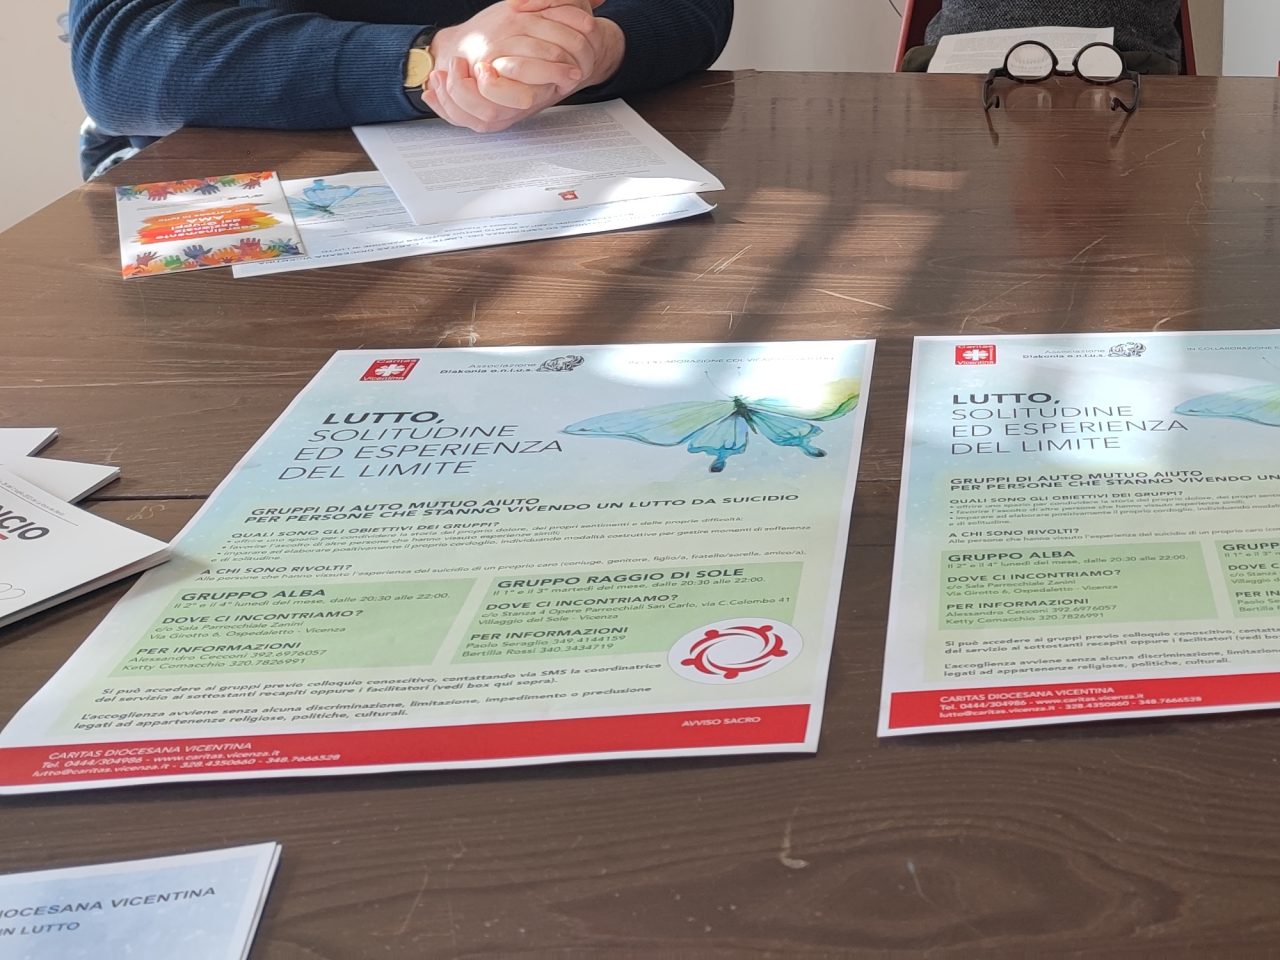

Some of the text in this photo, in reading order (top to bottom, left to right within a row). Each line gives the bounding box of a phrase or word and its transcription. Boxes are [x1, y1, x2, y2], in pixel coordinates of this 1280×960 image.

[186, 215, 224, 223] AMA
[952, 392, 1060, 405] LUTTO,
[322, 410, 444, 424] LUTTO,
[951, 405, 1132, 420] SOLITUDINE
[308, 424, 518, 442] SOLITUDINE
[951, 419, 1188, 438] ED ESPERIENZA
[293, 439, 562, 461] ED ESPERIENZA
[950, 436, 1120, 455] DEL LIMITE
[277, 460, 476, 480] DEL LIMITE
[949, 476, 1010, 484] GRUPPI
[1036, 473, 1083, 482] AUTO
[1087, 471, 1148, 479] MUTUO
[1153, 469, 1202, 478] AIUTO
[985, 481, 1062, 490] PERSONE
[1067, 479, 1100, 487] CHE
[1105, 477, 1173, 486] STANNO
[1177, 474, 1252, 483] VIVENDO
[243, 494, 799, 523] PER PERSONE CHE STANNO VIVENDO UN LUTTO DA SUICIDIO
[250, 497, 540, 516] GRUPPI DI AUTO MUTUO AIUTO
[276, 529, 319, 537] SONO
[347, 525, 413, 534] OBIETTIVI
[442, 521, 500, 529] GRUPPI?
[947, 550, 1075, 562] GRUPPO ALBA
[199, 567, 211, 575] A
[290, 564, 352, 572] RIVOLTI?
[946, 568, 1121, 583] DOVE CI INCONTRIAMO?
[496, 567, 744, 588] GRUPPO RAGGIO DI SOLE
[180, 588, 325, 601] GRUPPO ALBA
[485, 593, 678, 610] DOVE CI INCONTRIAMO?
[946, 598, 1088, 610] PER INFORMAZIONI
[161, 609, 363, 624] DOVE CI INCONTRIAMO?
[469, 626, 628, 640] PER INFORMAZIONI
[135, 641, 301, 654] PER INFORMAZIONI
[939, 686, 1114, 703] CARITAS DIOCESANA VICENTINA
[722, 715, 761, 724] SACRO
[48, 741, 252, 760] CARITAS DIOCESANA VICENTINA
[0, 887, 216, 919] IOCESANA VICENTINA
[20, 922, 80, 935] LUTTO
